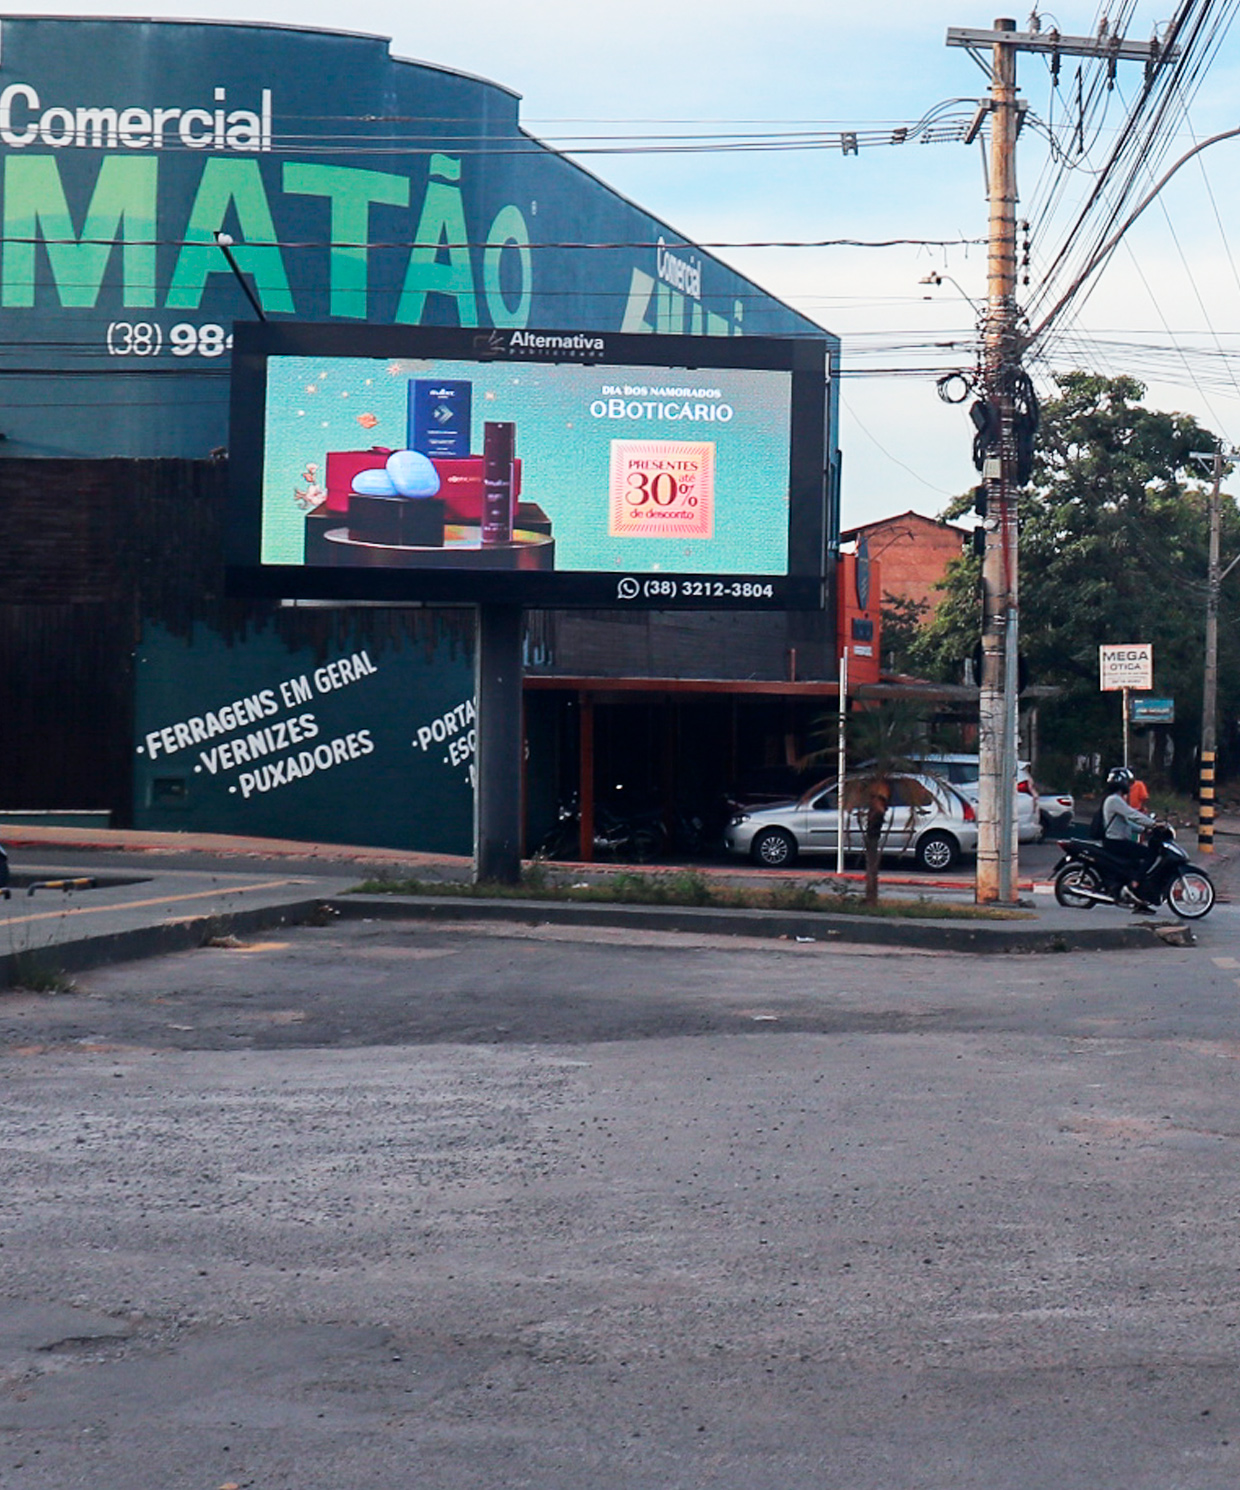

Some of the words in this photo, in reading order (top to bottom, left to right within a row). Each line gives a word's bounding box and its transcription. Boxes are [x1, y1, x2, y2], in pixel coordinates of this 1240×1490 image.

[0, 83, 272, 151] Comercial
[2, 153, 532, 329] MATÃO
[656, 236, 701, 301] Comercial
[107, 322, 162, 355] (38)
[509, 331, 604, 349] Alternativa
[602, 385, 621, 396] DIA
[625, 385, 648, 397] DOS
[650, 387, 721, 398] NAMORADOS
[628, 459, 698, 471] PRESENTES
[678, 474, 695, 482] até
[630, 509, 643, 518] de
[645, 510, 694, 520] desconto
[643, 580, 677, 597] (38)
[682, 582, 774, 598] 3212-3804
[1103, 651, 1148, 661] MEGA
[145, 688, 279, 760] FERRAGENS
[279, 675, 312, 710] EM
[313, 650, 378, 694] GERAL
[417, 696, 478, 752] PORTA
[199, 713, 319, 775] VERNIZES
[238, 729, 375, 799] PUXADORES
